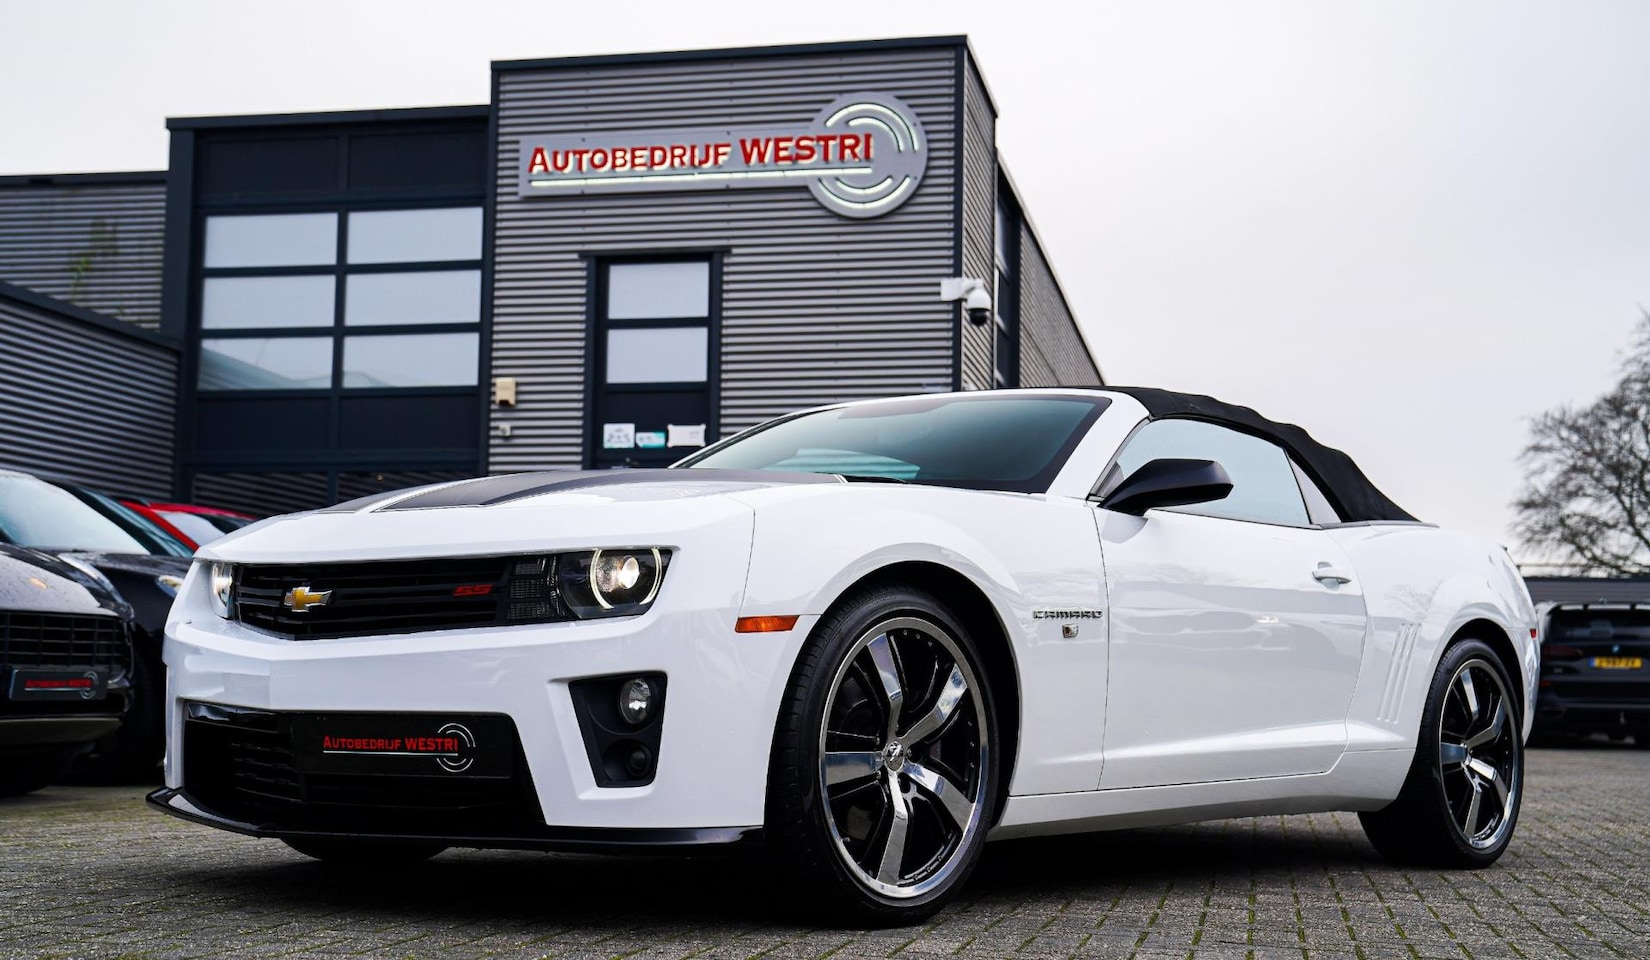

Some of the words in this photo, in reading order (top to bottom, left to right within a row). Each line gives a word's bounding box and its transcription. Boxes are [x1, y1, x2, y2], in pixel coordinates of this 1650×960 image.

[528, 143, 732, 174] AUTOBEDRIJF
[739, 133, 873, 166] WESTRI
[453, 584, 493, 597] SS
[1033, 610, 1103, 620] CAMARO
[323, 735, 402, 750] AUTOBEDRIJF
[404, 737, 459, 751] WESTRI
